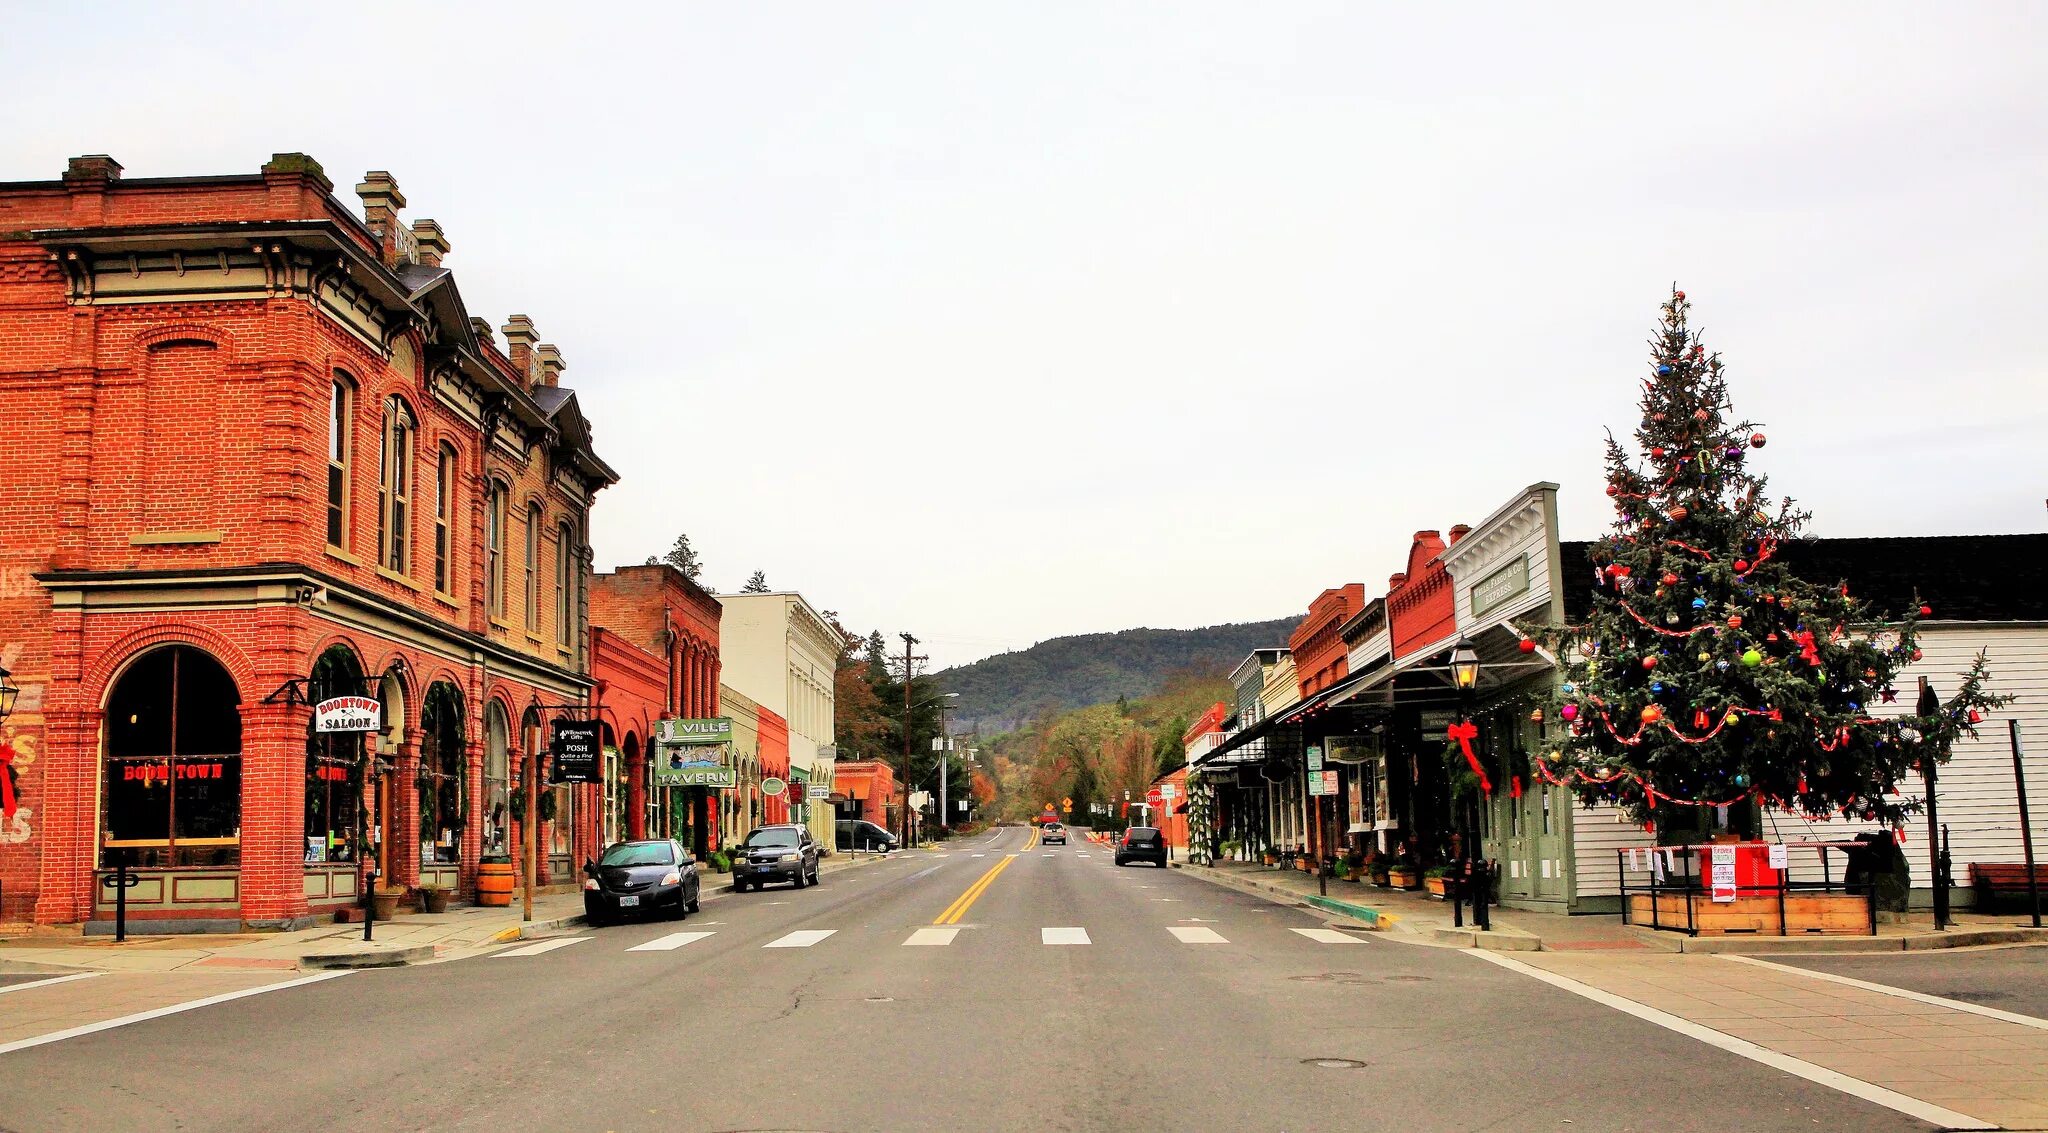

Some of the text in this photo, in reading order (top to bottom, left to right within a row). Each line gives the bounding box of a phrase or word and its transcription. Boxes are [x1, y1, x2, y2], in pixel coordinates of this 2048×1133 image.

[318, 697, 379, 716] BOOMTOWN
[325, 717, 371, 729] SALOON
[656, 720, 729, 742] J VILLE
[566, 744, 588, 752] POSH
[123, 763, 223, 781] BOOM TOWN
[658, 772, 729, 784] TAVERN
[1147, 794, 1163, 803] STOP
